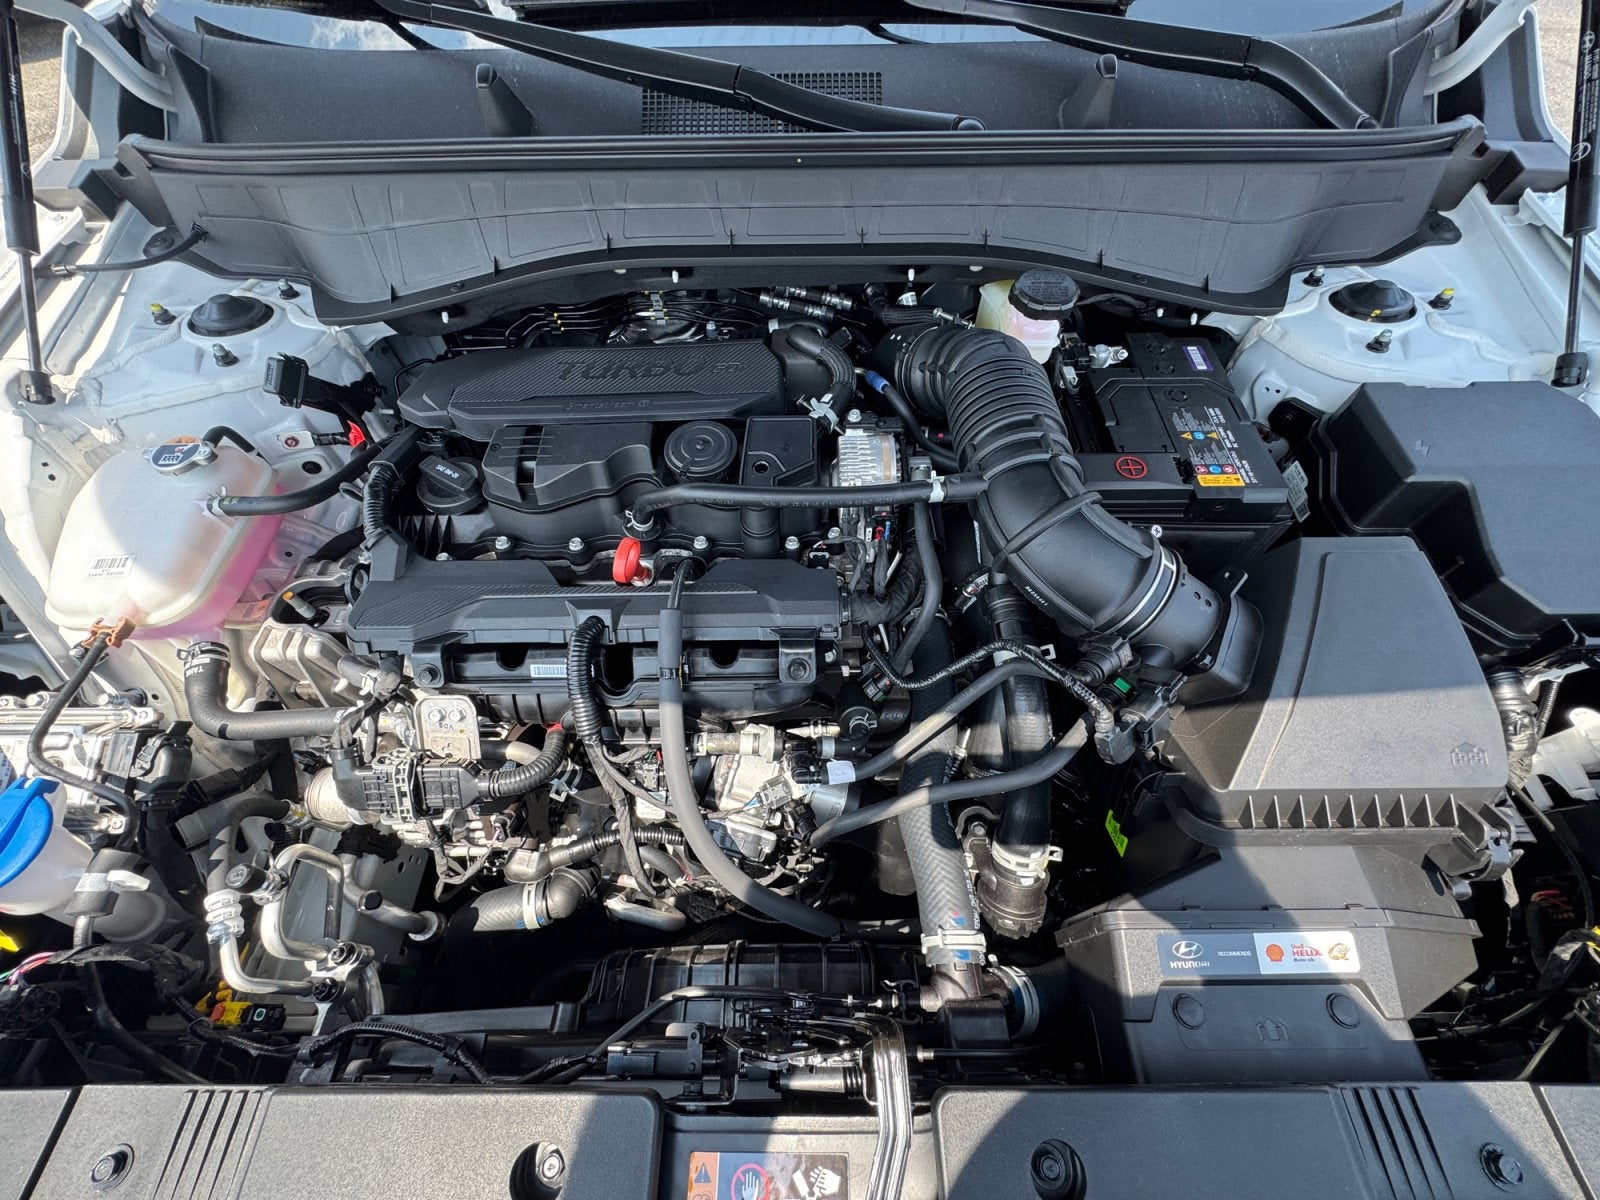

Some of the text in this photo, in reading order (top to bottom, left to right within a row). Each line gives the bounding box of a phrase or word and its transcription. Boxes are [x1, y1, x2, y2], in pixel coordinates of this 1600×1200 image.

[558, 356, 706, 381] TURBO
[1291, 949, 1322, 957] HELIX
[1169, 961, 1210, 969] HYUNDAI
